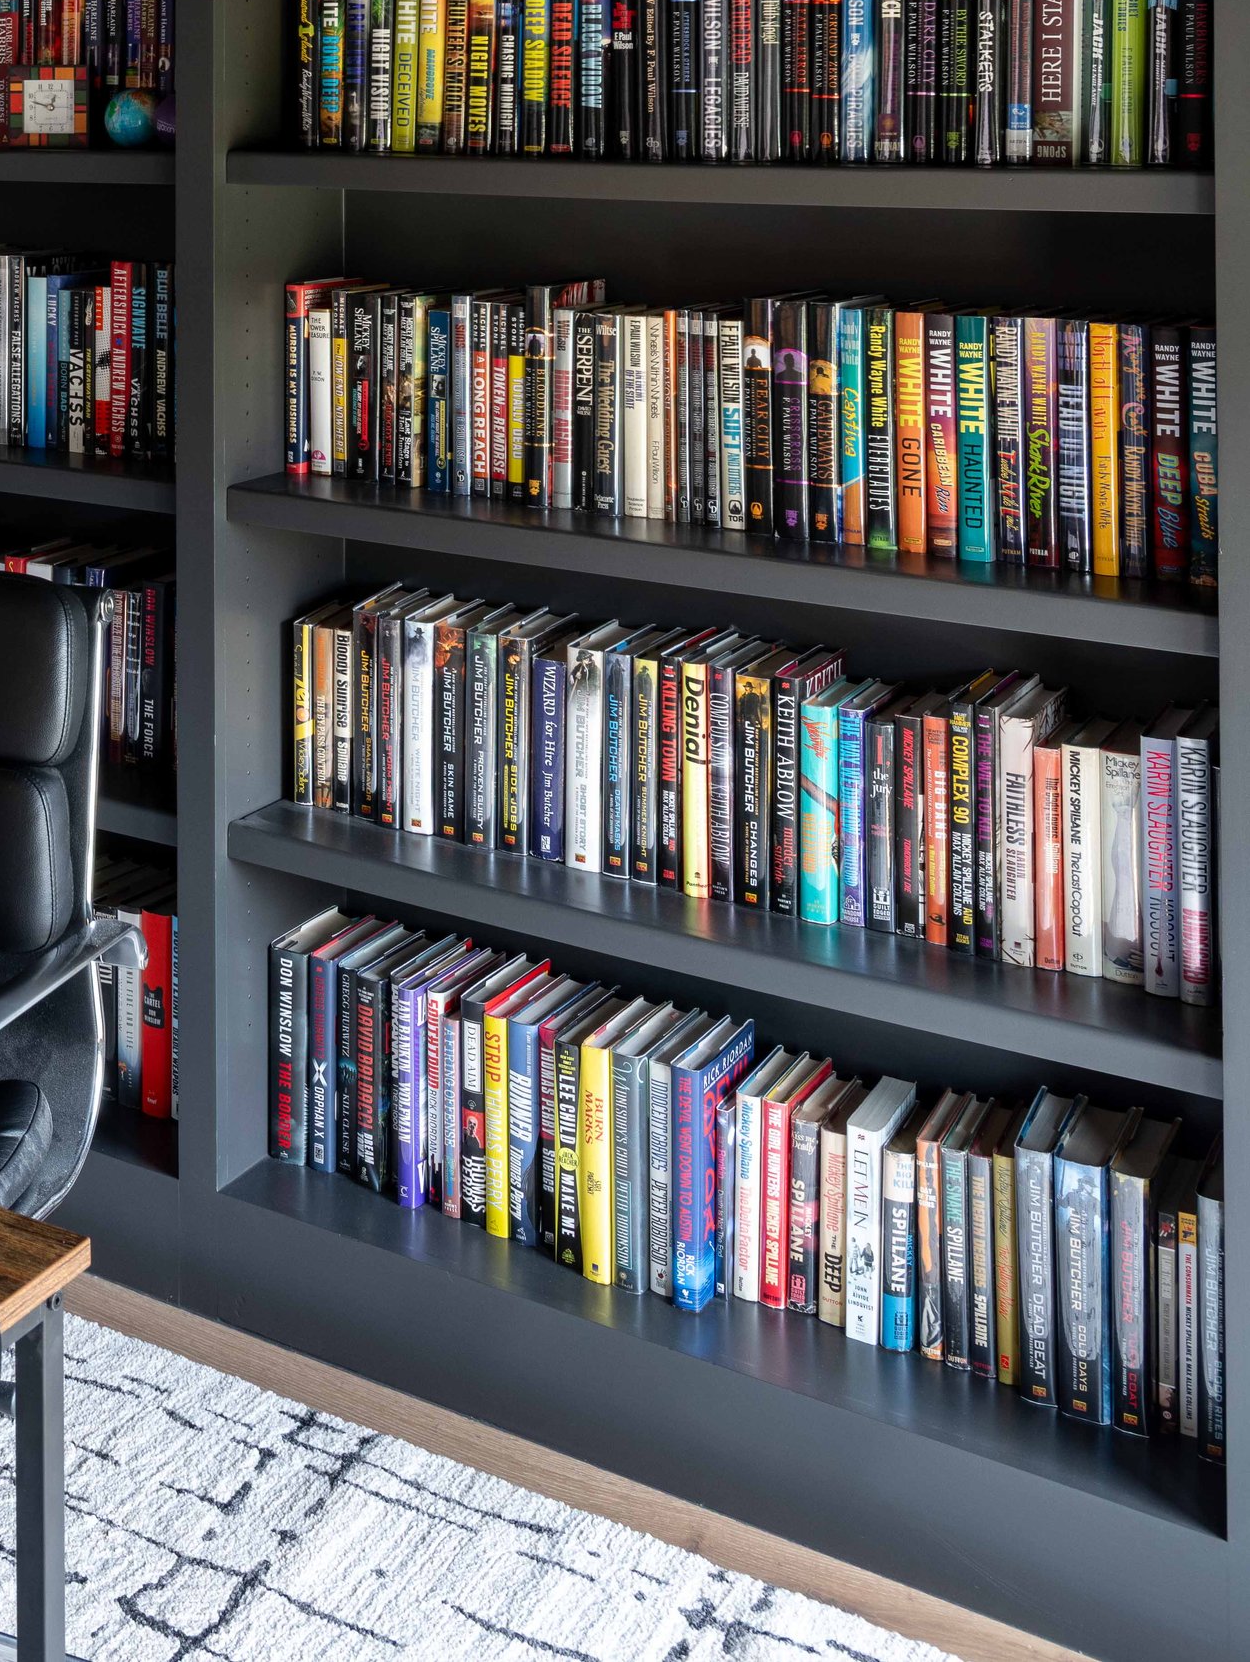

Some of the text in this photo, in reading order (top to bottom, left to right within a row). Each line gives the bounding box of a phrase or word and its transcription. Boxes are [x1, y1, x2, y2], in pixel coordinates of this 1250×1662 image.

[369, 28, 391, 120] NIGHT VISION
[397, 53, 412, 126] DECEIVED
[469, 36, 488, 132] NIGHT MOVES
[524, 40, 544, 102] SHADOW
[979, 11, 993, 92] STALKERS
[1041, 47, 1061, 102] HERE
[704, 78, 721, 148] LEGACIES
[1037, 146, 1066, 158] SPONG
[112, 269, 126, 432] AFTERSHOCK ANDREW VACHSS
[132, 287, 146, 349] SIGNWAVE
[960, 342, 982, 350] RANDY
[11, 330, 21, 424] FALSE ALLEGATIONS
[289, 364, 296, 377] IS
[290, 381, 296, 397] MY
[577, 335, 593, 405] SERPENT
[868, 325, 890, 511] Randy Wayne White EVERGLADES
[900, 359, 921, 497] WHITE GONE
[959, 363, 984, 529] WHITE HAUNTED
[145, 588, 155, 666] DON WINSLOW
[144, 700, 154, 757] THE FORCE
[336, 634, 349, 781] Bloody Sunrise Spillane
[662, 679, 677, 782] KILLING TOWN
[684, 676, 704, 764] Denial
[776, 694, 795, 821] KEITH ABLOW
[871, 783, 891, 797] jury
[873, 769, 888, 781] the
[952, 736, 968, 824] COMPLEX 90
[1007, 772, 1026, 845] FAITHLESS
[1147, 750, 1173, 891] KARIN SLAUGHTER
[144, 998, 160, 1008] CARTEL
[280, 958, 292, 1150] DON WINSLOW THE BORDER
[485, 1031, 500, 1083] STRIP
[585, 1092, 595, 1146] MARKS
[595, 1098, 604, 1142] BURN
[791, 1179, 805, 1263] SPILLANE
[891, 1208, 906, 1293] SPILLANE
[1033, 1292, 1047, 1379] DEAD BEAT
